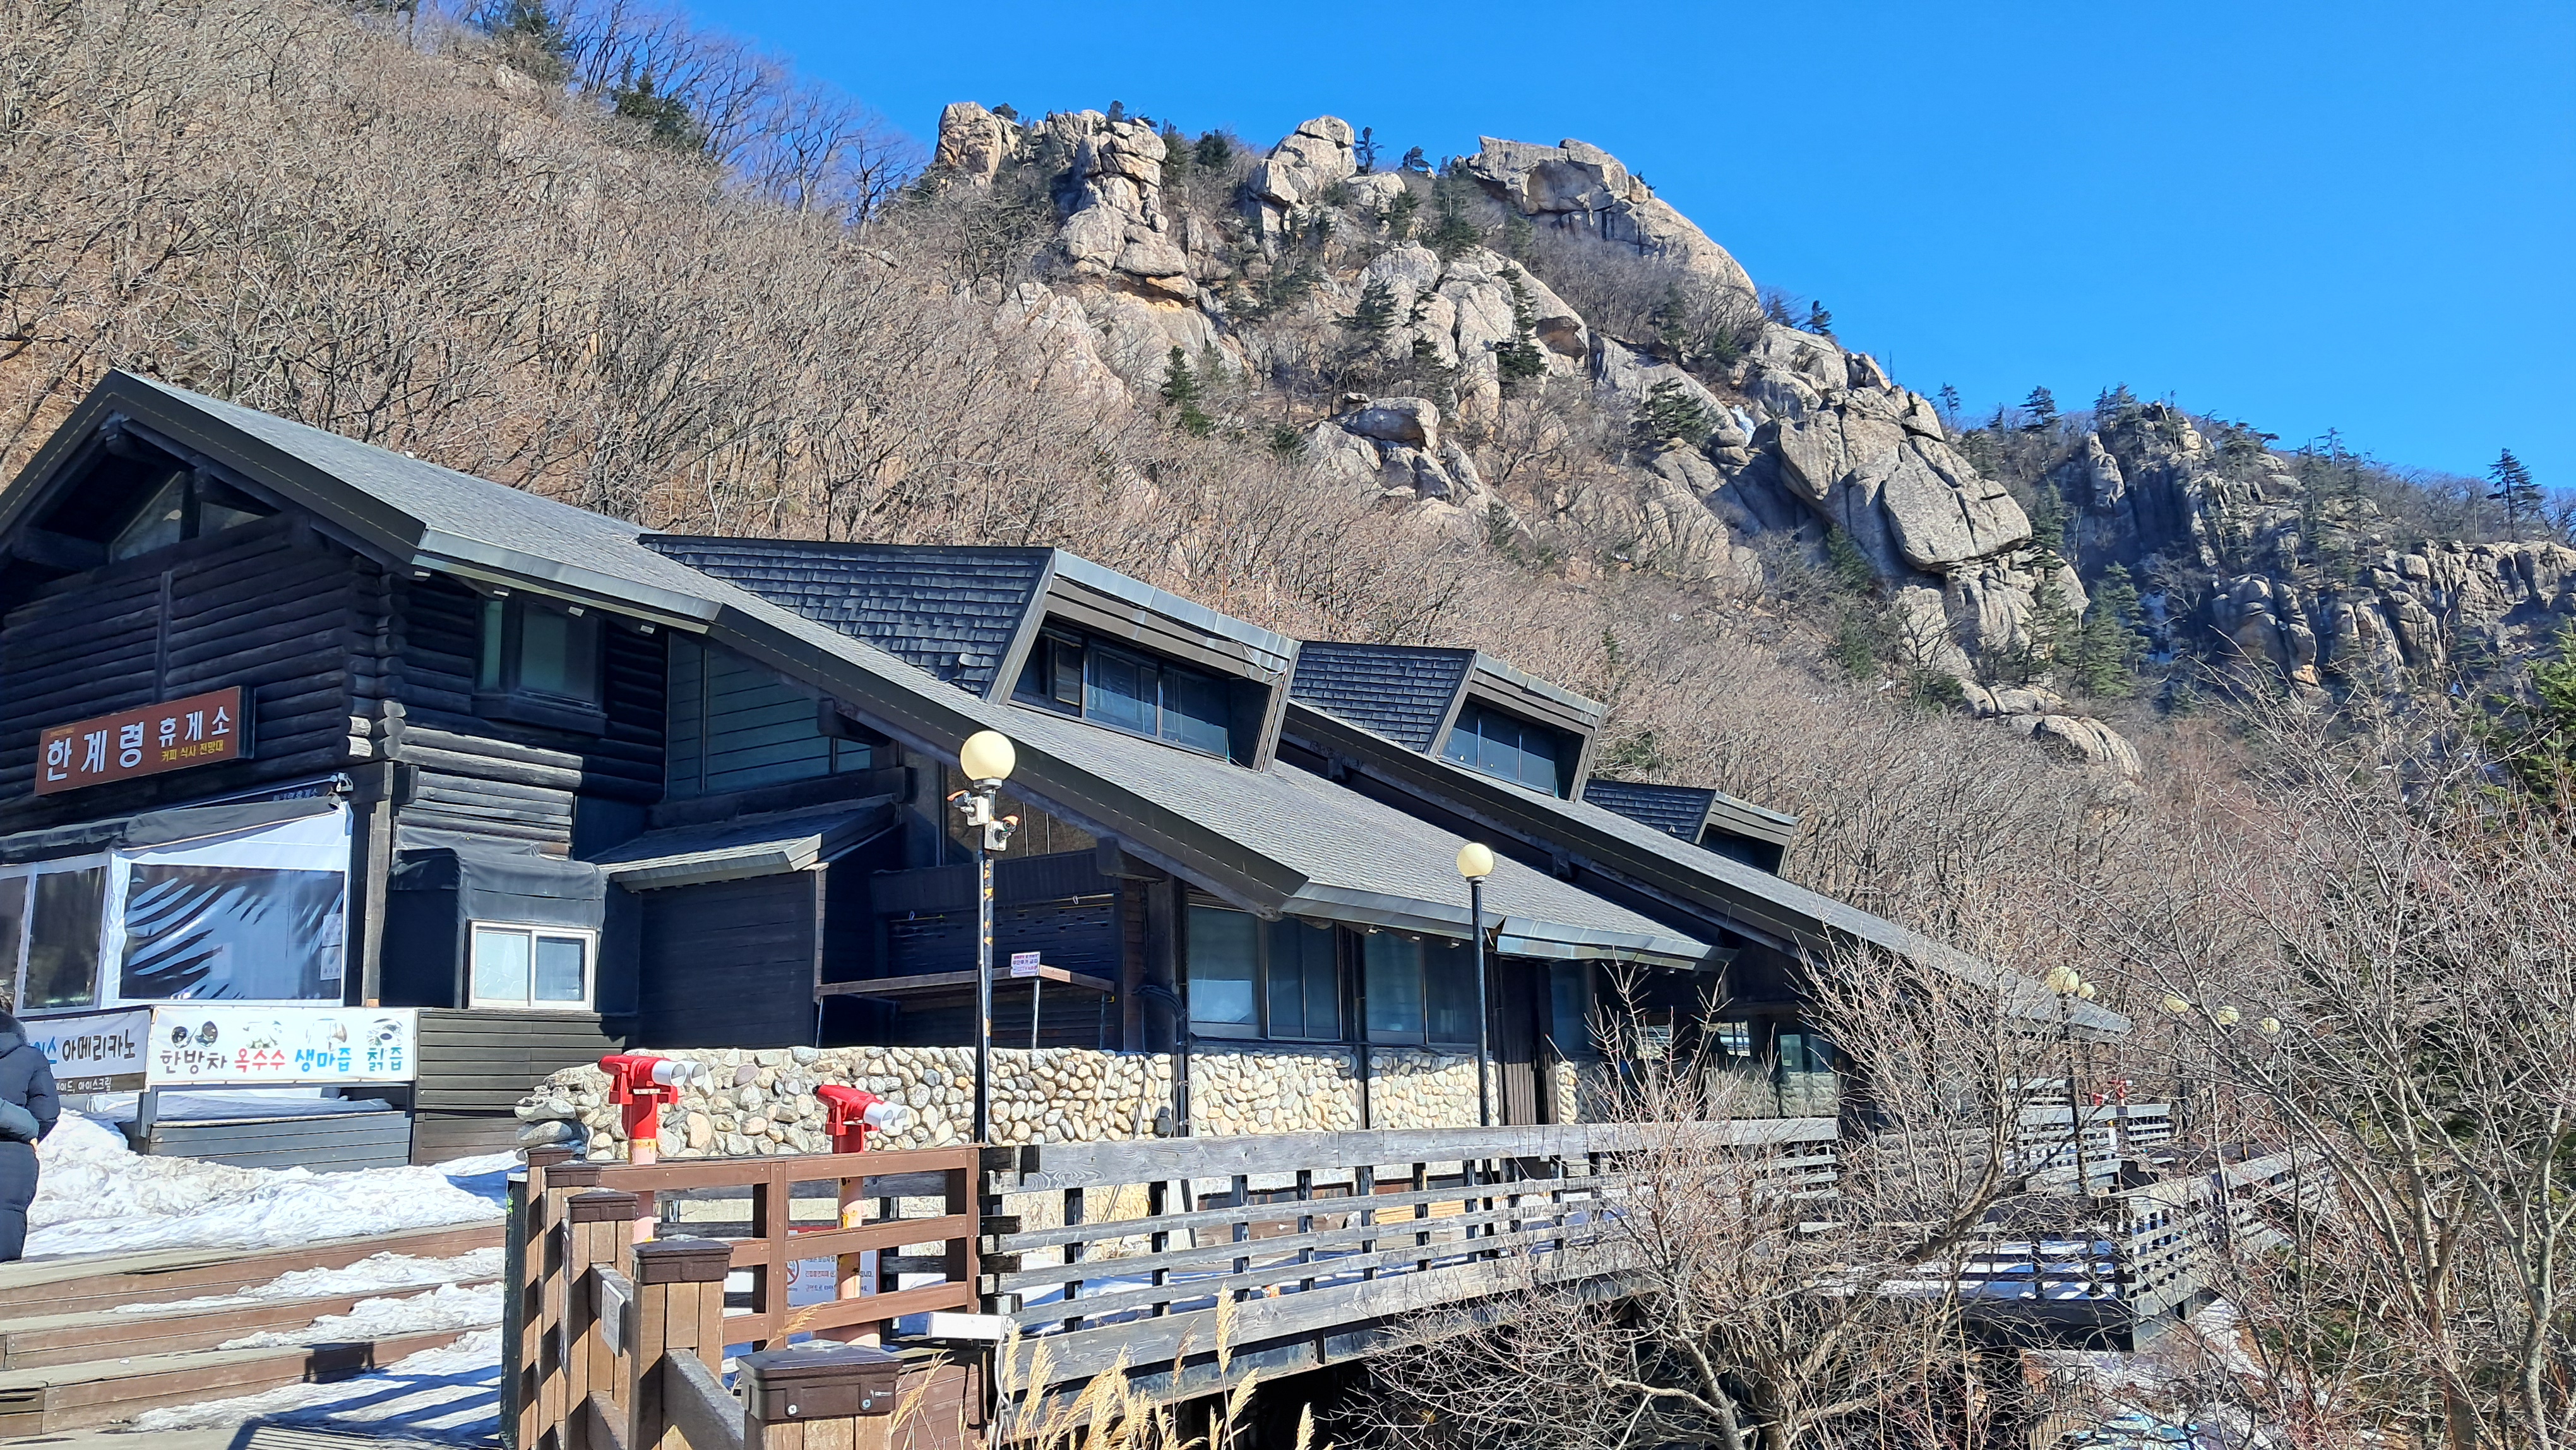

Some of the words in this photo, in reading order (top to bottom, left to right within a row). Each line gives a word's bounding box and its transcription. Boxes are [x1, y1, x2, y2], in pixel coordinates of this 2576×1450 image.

[46, 721, 145, 782] 한계령
[158, 706, 230, 748] 휴게소
[161, 749, 177, 762] 커피
[180, 745, 196, 758] 식사
[200, 740, 224, 755] 전망대
[63, 1029, 136, 1062] 아메리카노
[159, 1049, 227, 1074] 한방차
[234, 1048, 285, 1073] 옥수수
[295, 1047, 352, 1072] 생마즙
[78, 1077, 112, 1091] 아이스크림
